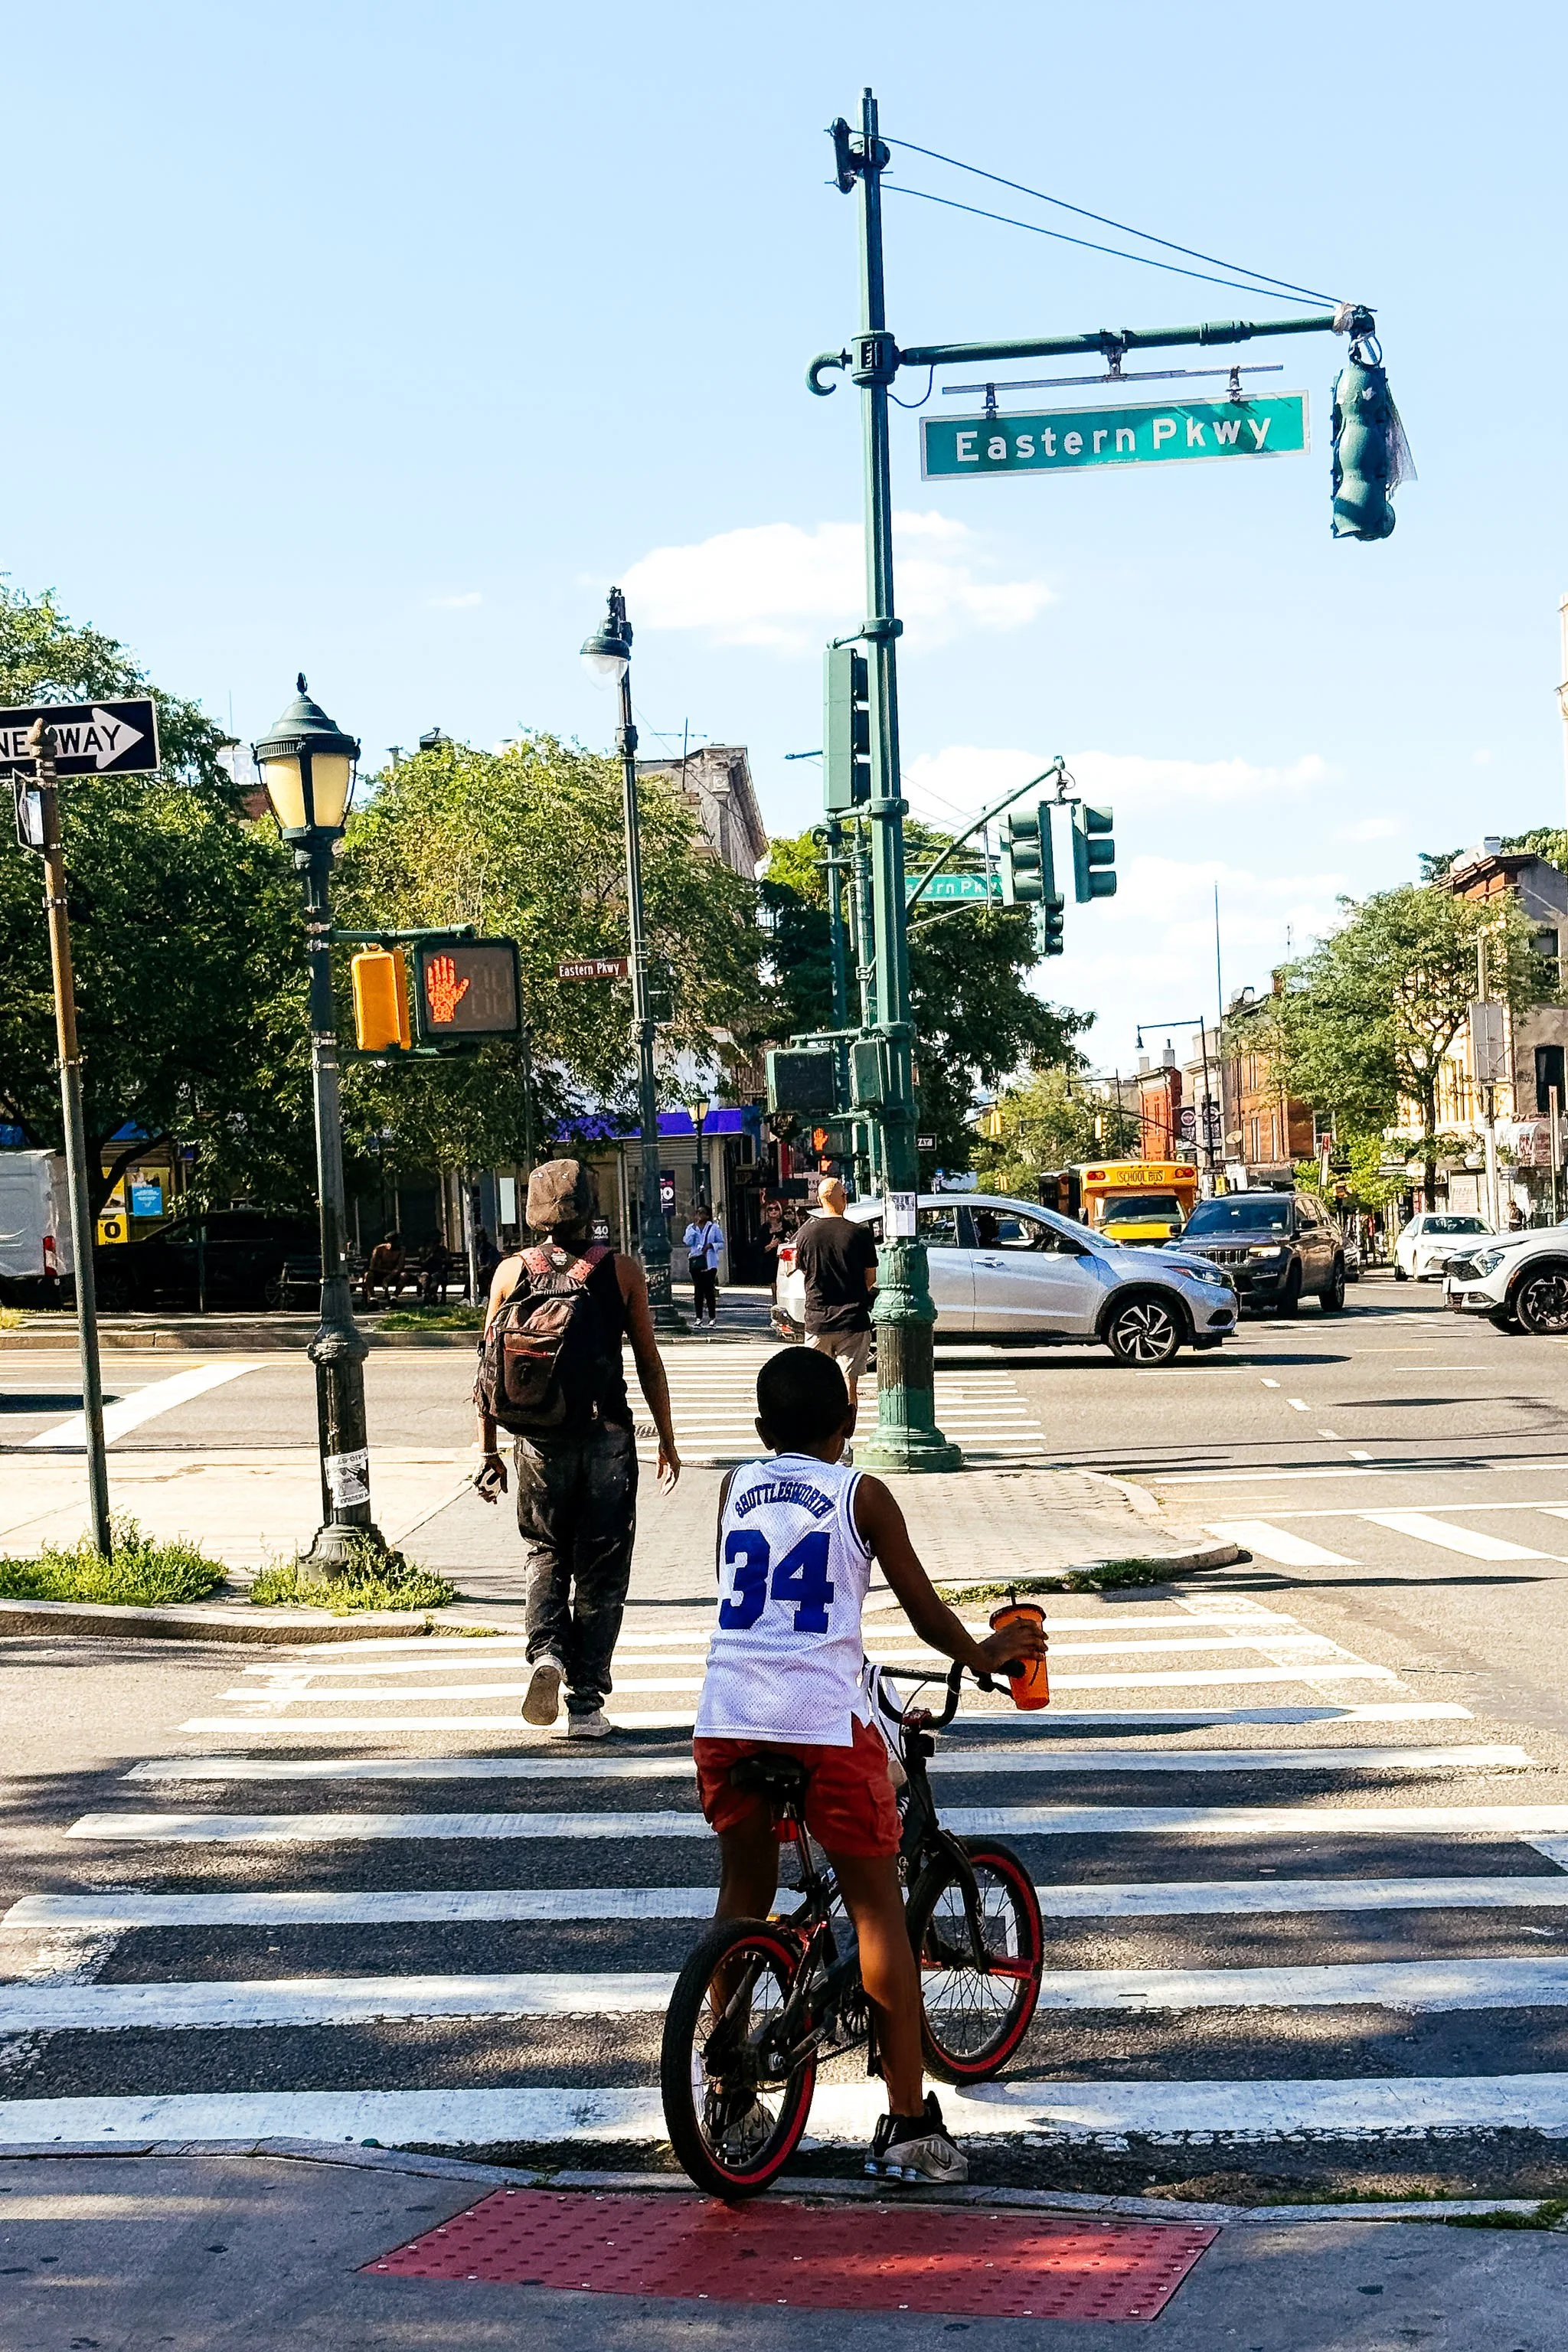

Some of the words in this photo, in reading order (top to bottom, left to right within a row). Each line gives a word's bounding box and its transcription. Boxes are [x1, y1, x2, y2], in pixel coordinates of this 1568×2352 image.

[956, 426, 1136, 462] Eastern
[1152, 417, 1271, 450] Pkwy
[0, 730, 30, 758] NE
[58, 724, 121, 755] WAY
[559, 965, 593, 978] Eastern
[596, 962, 619, 976] Pkwy
[1119, 1171, 1146, 1183] SCHOOL
[734, 1481, 835, 1520] SHUTTLESWORTH
[718, 1529, 835, 1635] 34
